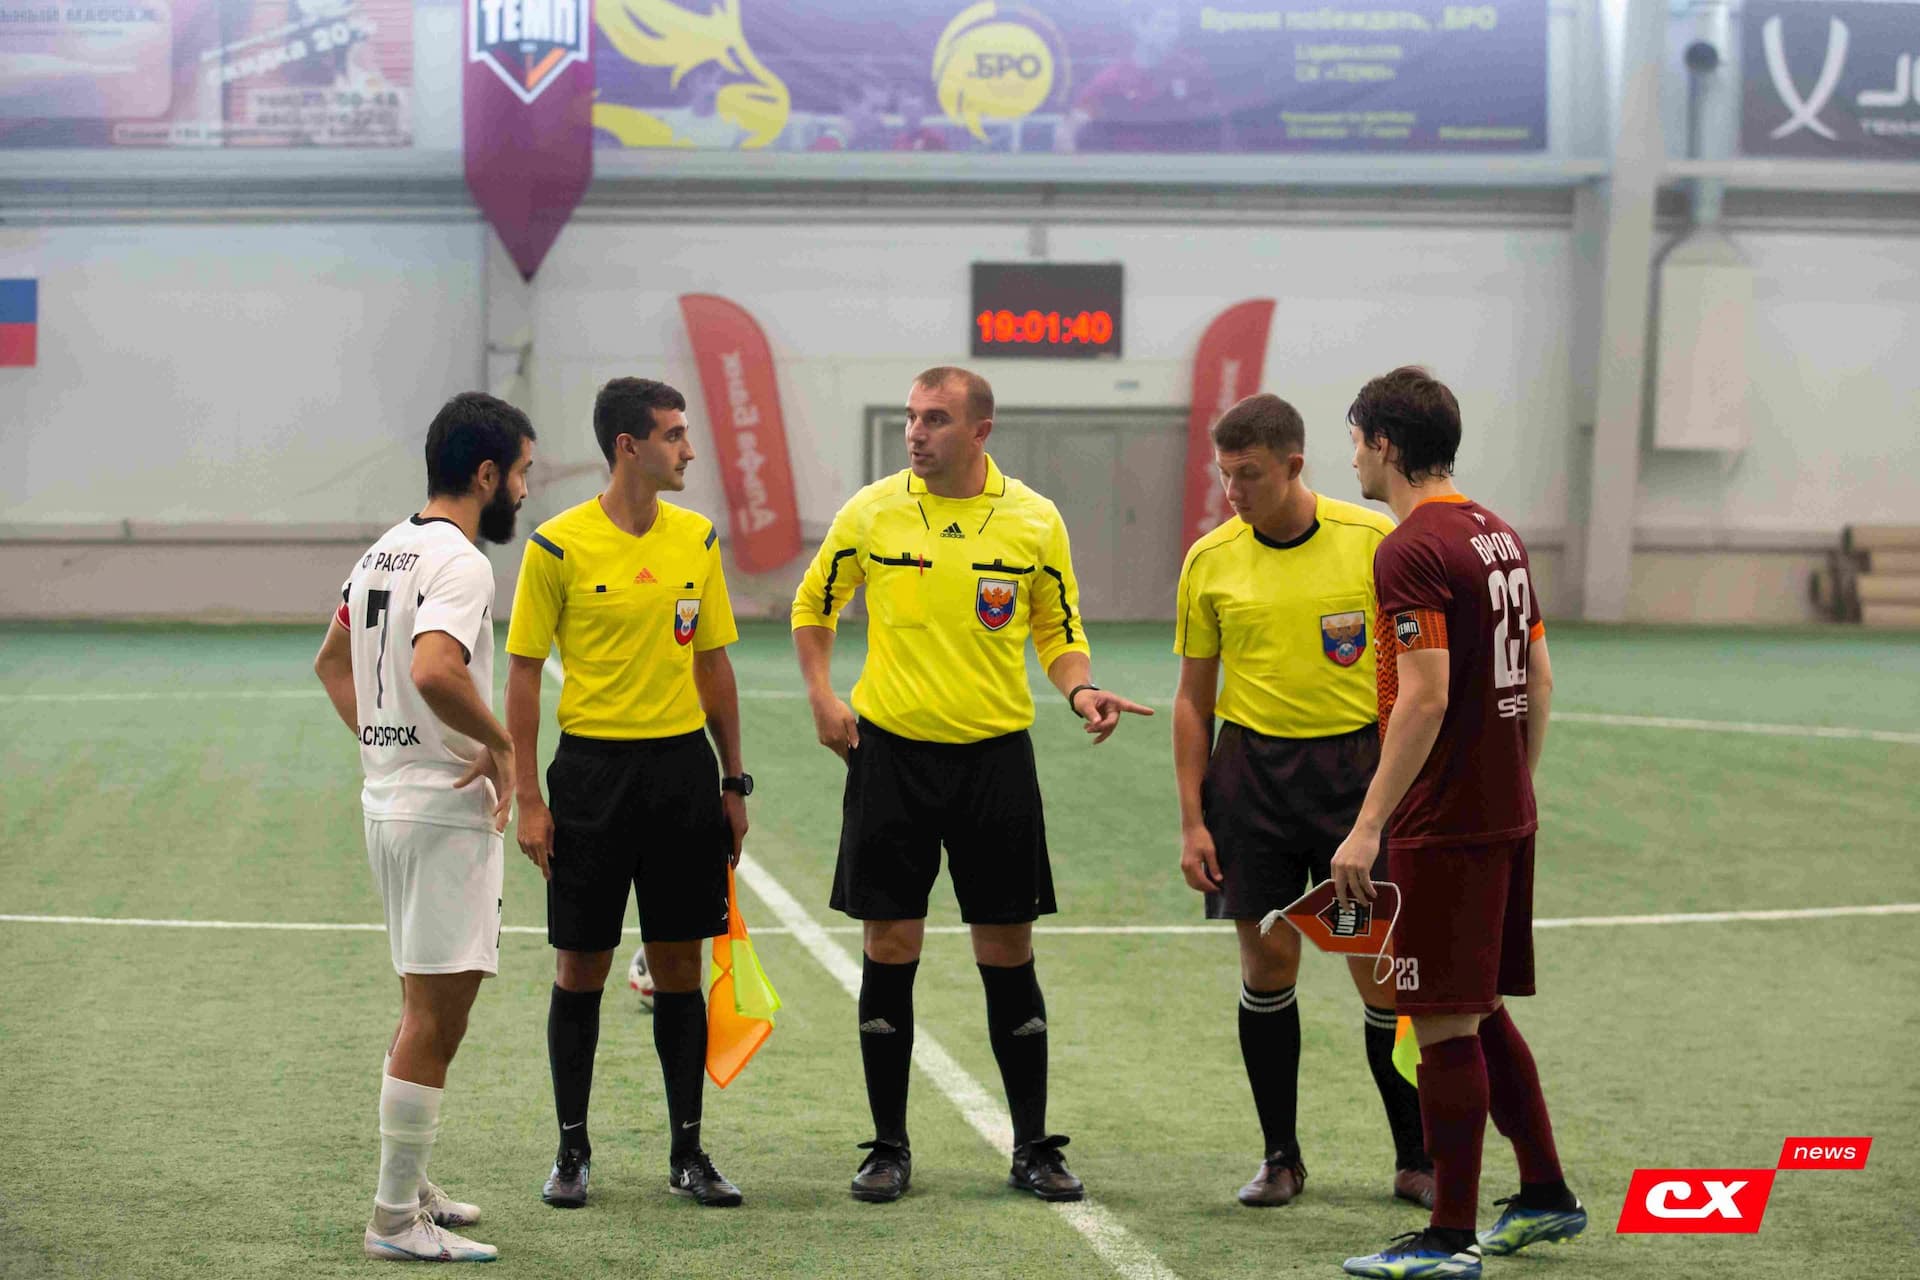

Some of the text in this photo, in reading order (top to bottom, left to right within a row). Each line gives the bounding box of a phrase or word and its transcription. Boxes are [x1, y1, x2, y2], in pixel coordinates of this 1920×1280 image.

[480, 0, 577, 45] ТЕМП
[365, 589, 392, 709] 7
[1488, 567, 1531, 689] 23
[1397, 958, 1420, 990] 23
